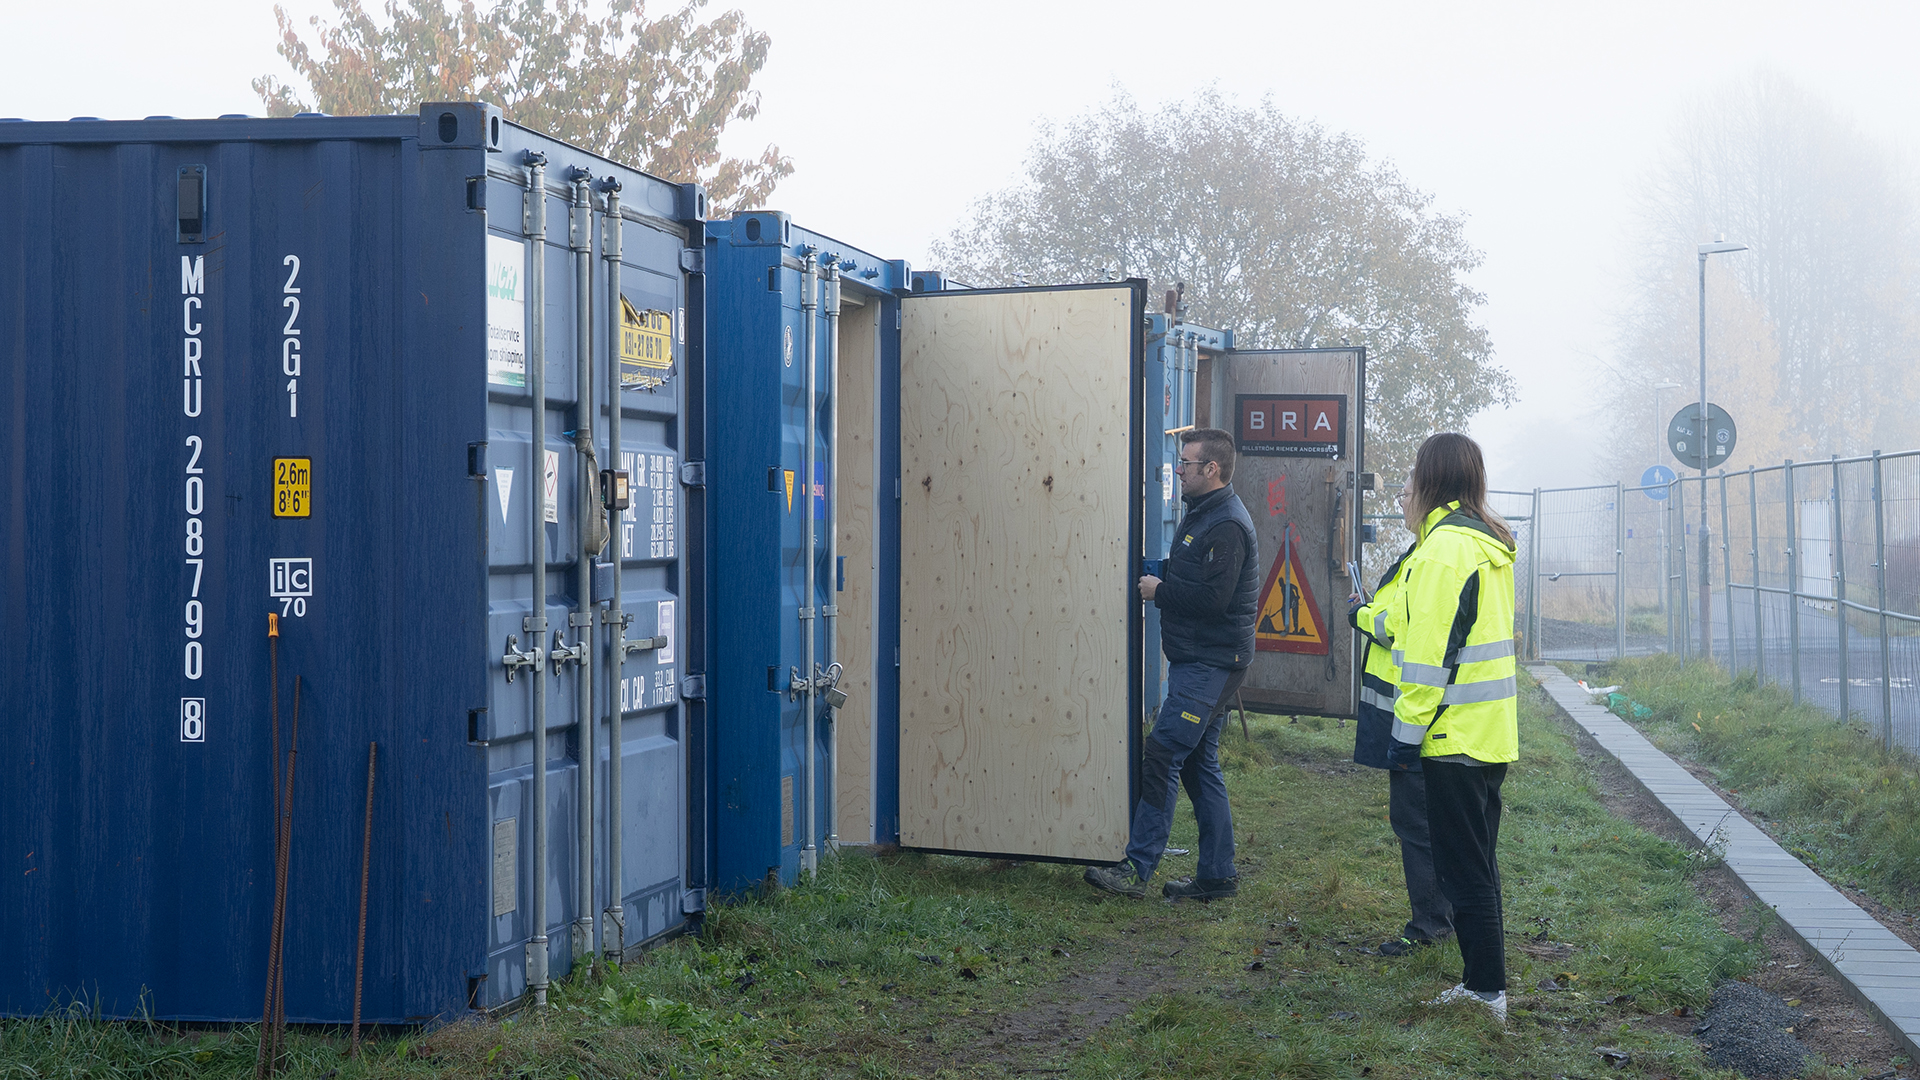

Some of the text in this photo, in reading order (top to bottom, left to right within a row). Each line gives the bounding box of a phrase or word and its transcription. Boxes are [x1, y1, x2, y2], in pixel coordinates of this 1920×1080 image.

[282, 254, 301, 418] 22G1
[499, 348, 524, 369] shipping
[278, 462, 308, 488] 2,6m
[181, 255, 204, 739] MCRU 208790 8
[621, 524, 634, 558] NET
[279, 597, 306, 618] 70
